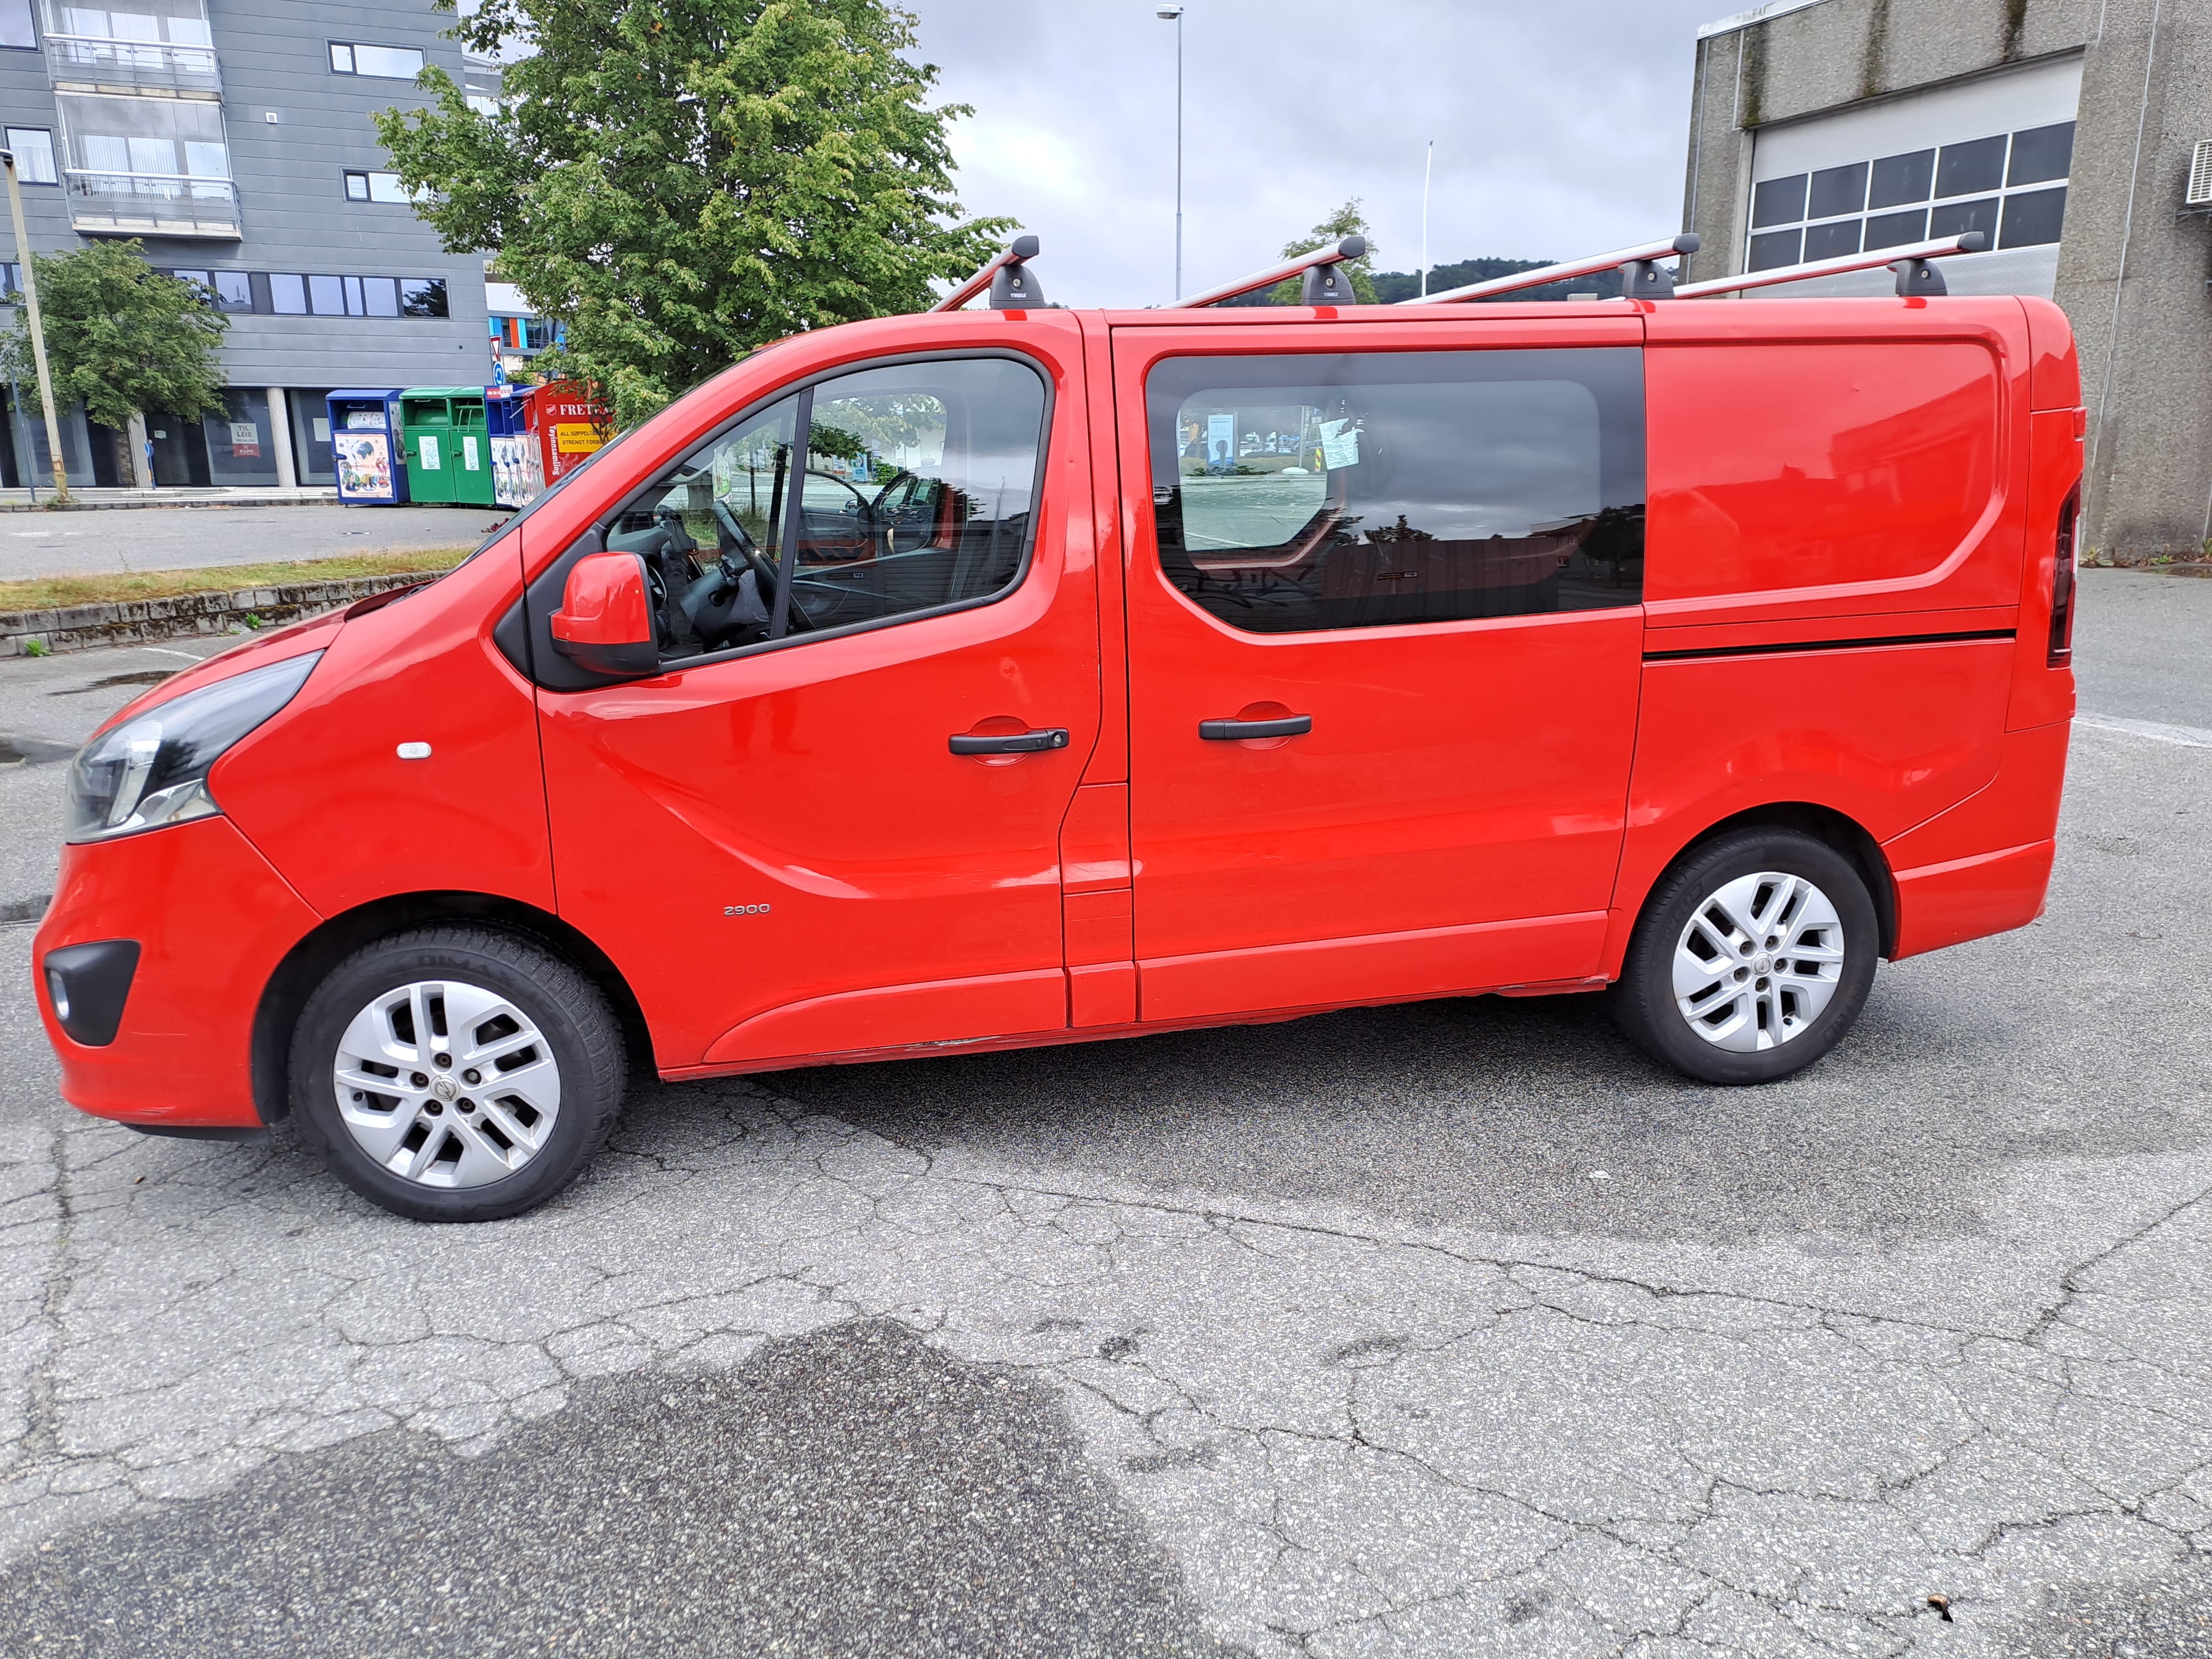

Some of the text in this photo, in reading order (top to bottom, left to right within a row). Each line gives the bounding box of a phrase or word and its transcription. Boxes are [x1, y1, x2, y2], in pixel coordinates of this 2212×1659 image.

[560, 404, 611, 415] FRET
[548, 425, 561, 476] Tøyinnsamling
[724, 904, 770, 916] 2900
